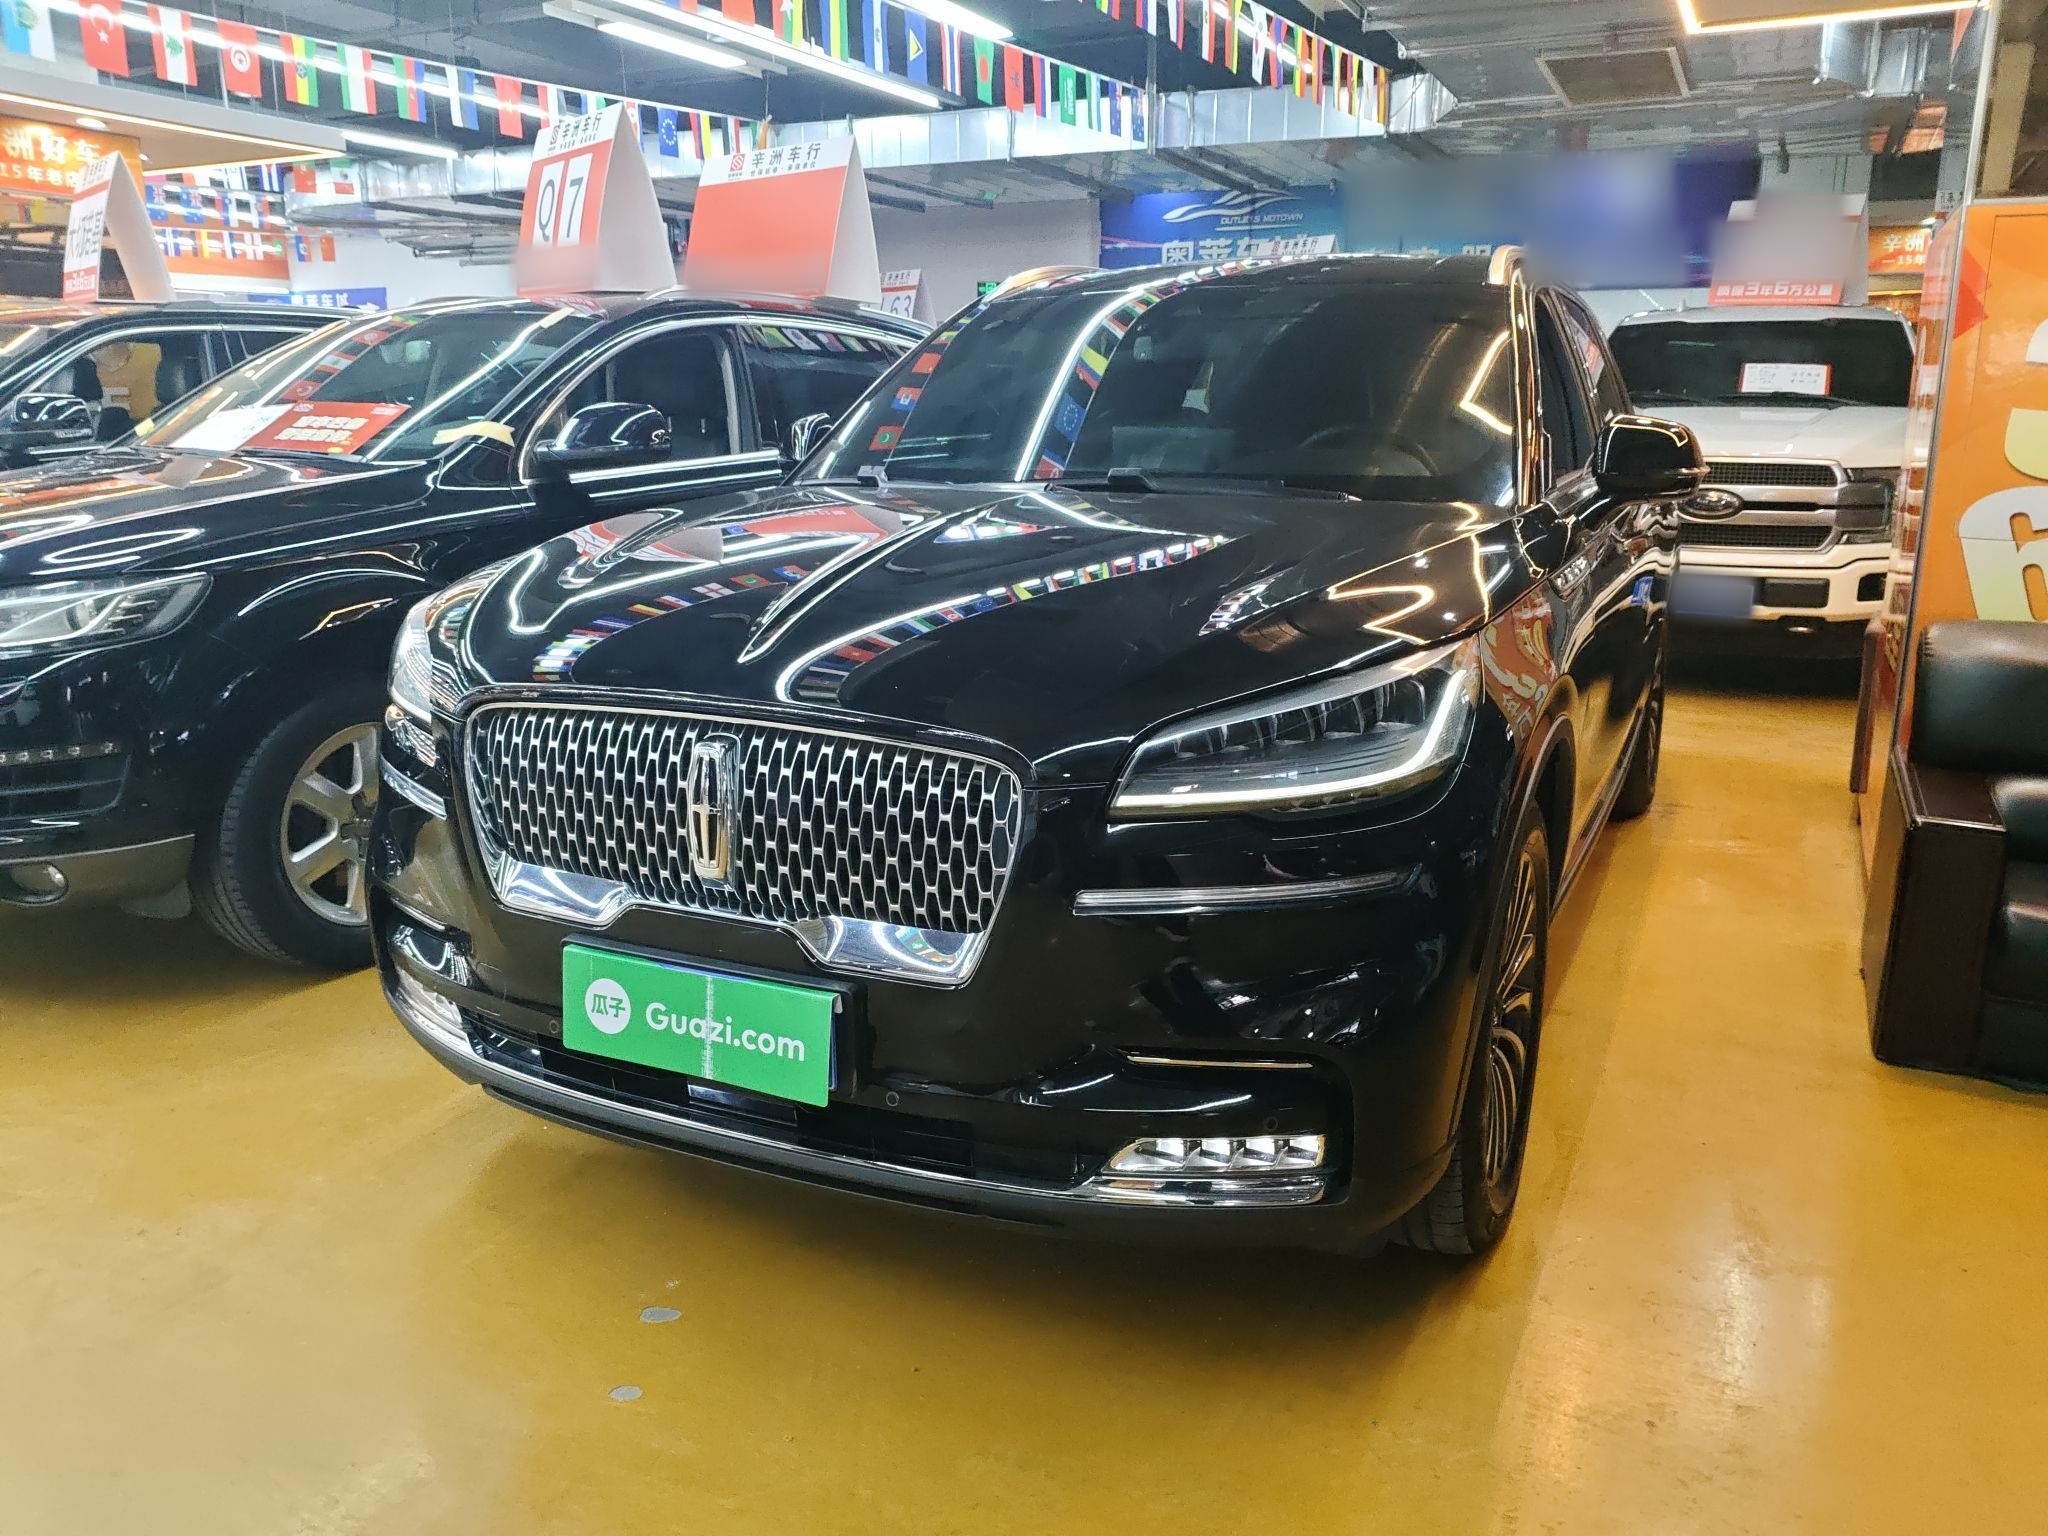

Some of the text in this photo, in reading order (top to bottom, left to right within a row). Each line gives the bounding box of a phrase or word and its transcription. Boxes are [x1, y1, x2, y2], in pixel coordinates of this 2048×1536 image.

[751, 142, 822, 168] 辛洲车行
[538, 176, 584, 242] Q7
[591, 993, 626, 1018] 瓜子
[645, 1001, 805, 1062] Guazi.com
